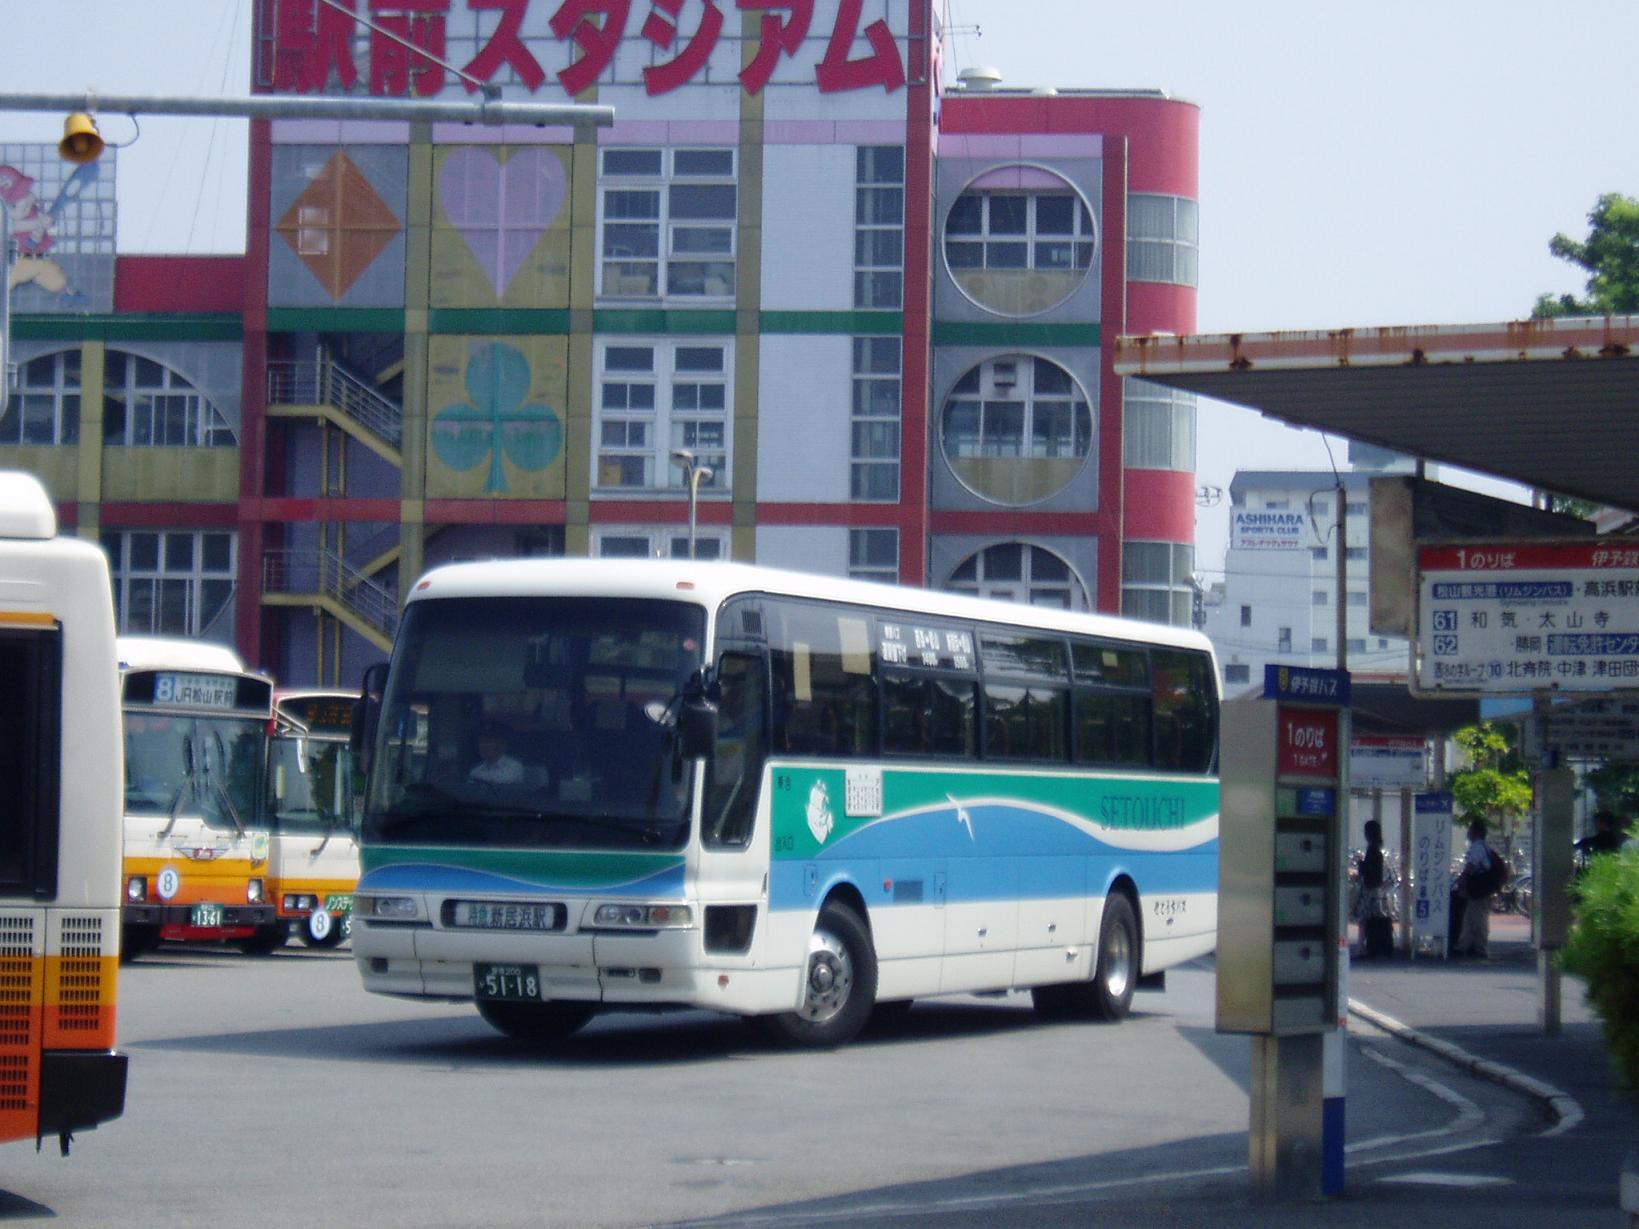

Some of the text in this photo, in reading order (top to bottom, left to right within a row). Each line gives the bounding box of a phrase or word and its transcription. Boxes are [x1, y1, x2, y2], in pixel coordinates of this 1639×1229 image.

[272, 0, 906, 96] 駅前スタジアム
[1236, 513, 1304, 525] ASHIHARA
[1241, 526, 1275, 534] SPORTS
[1456, 551, 1516, 569] 1のりば
[1434, 611, 1610, 629] 61 和気・太山寺
[1434, 636, 1456, 654] 62
[1592, 661, 1639, 678] 津田団
[157, 679, 173, 701] 8
[1287, 721, 1325, 749] 1のりば
[1100, 796, 1185, 831] SETOUCHI
[1431, 819, 1446, 913] リムジンバス
[163, 871, 174, 891] 8
[316, 913, 325, 931] 8
